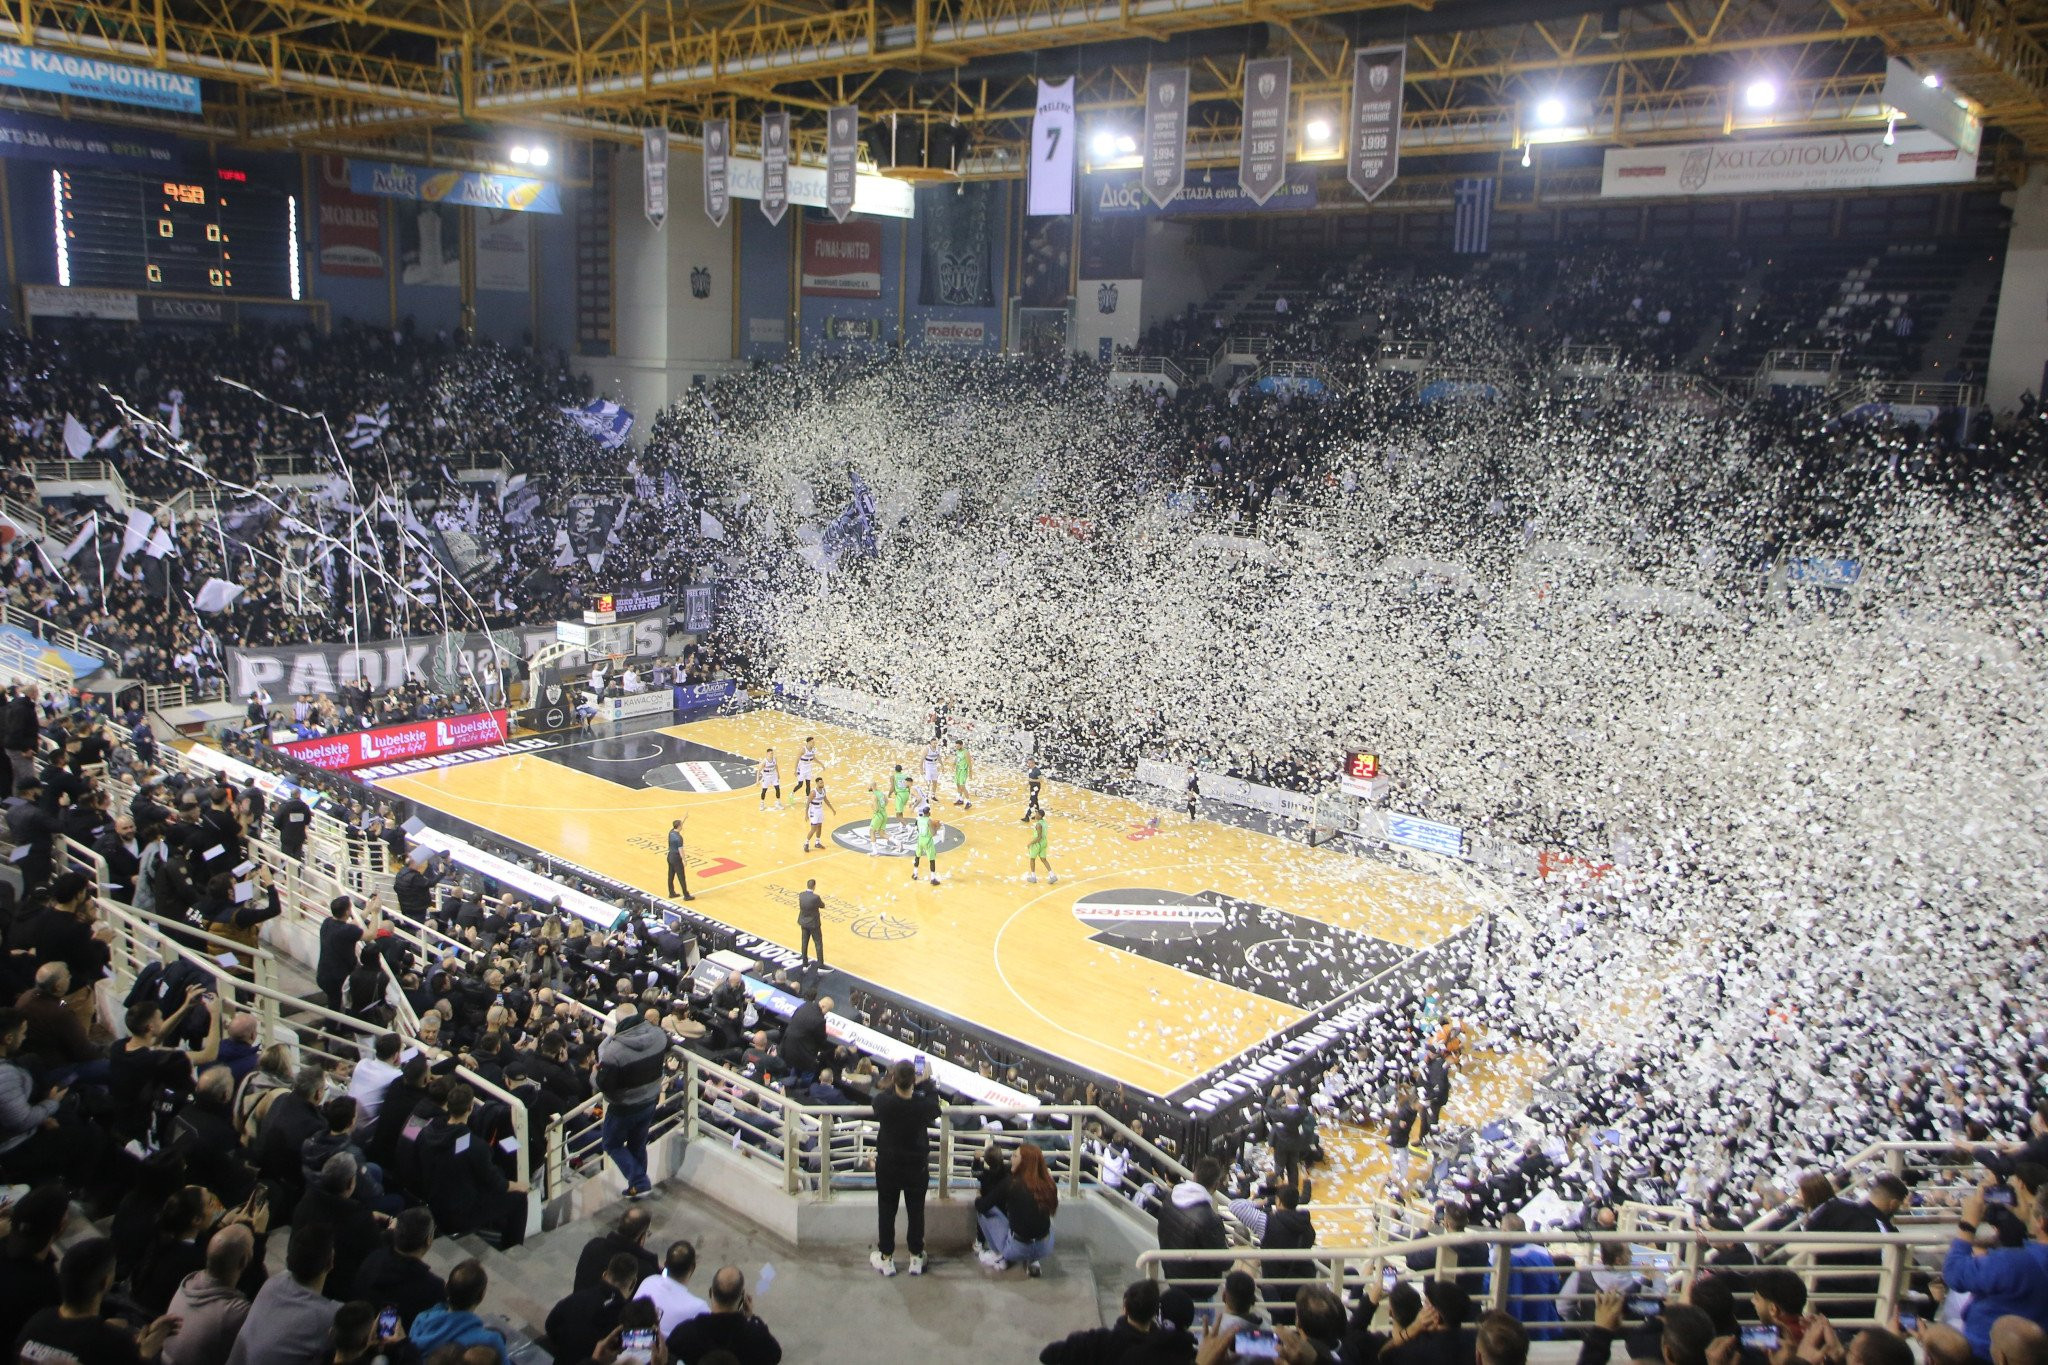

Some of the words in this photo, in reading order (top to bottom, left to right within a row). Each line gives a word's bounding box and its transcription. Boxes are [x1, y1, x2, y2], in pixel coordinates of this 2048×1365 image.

[31, 50, 196, 96] ΚΑΘΑΡΙΟΤΗΤΑΣ
[1046, 127, 1062, 162] 7
[1251, 141, 1275, 155] 1995
[1360, 134, 1387, 150] 1999
[1152, 148, 1176, 161] 1994
[1714, 139, 1884, 169] χατζόπουλος
[1099, 183, 1142, 211] Διός
[320, 205, 378, 226] MORRIS
[926, 323, 983, 339] mateco
[600, 602, 613, 612] 22
[237, 643, 430, 698] PAOK
[623, 694, 664, 708] KAWACOM
[450, 719, 498, 736] lubelskie
[375, 730, 427, 749] lubelskie
[1353, 761, 1375, 778] 22
[1075, 906, 1223, 919] winmasters
[745, 936, 804, 972] PAOK
[827, 1015, 848, 1031] AFT
[848, 1031, 891, 1055] Panasonic
